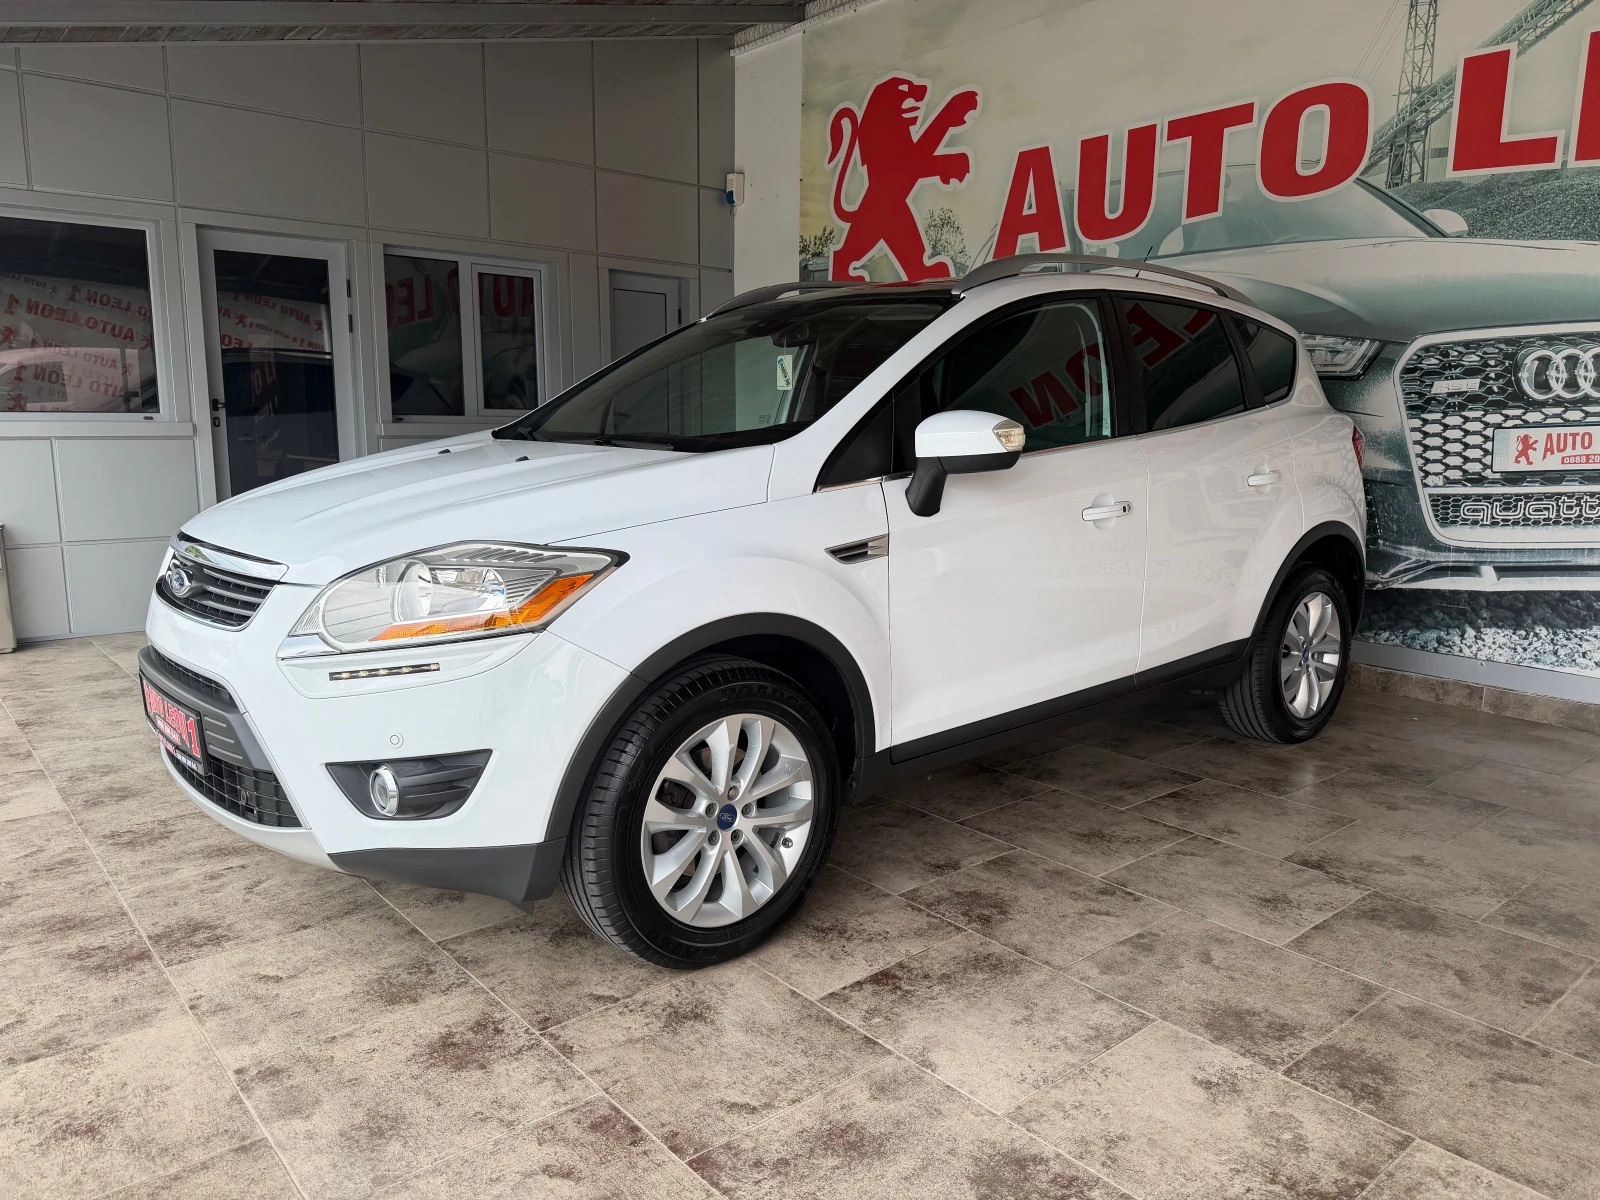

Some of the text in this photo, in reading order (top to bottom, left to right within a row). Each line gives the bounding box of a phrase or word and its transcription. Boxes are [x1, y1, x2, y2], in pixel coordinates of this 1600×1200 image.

[992, 82, 1370, 260] AUTO
[1542, 431, 1593, 462] AUTO
[1563, 455, 1586, 464] 0888
[187, 717, 200, 758] 1
